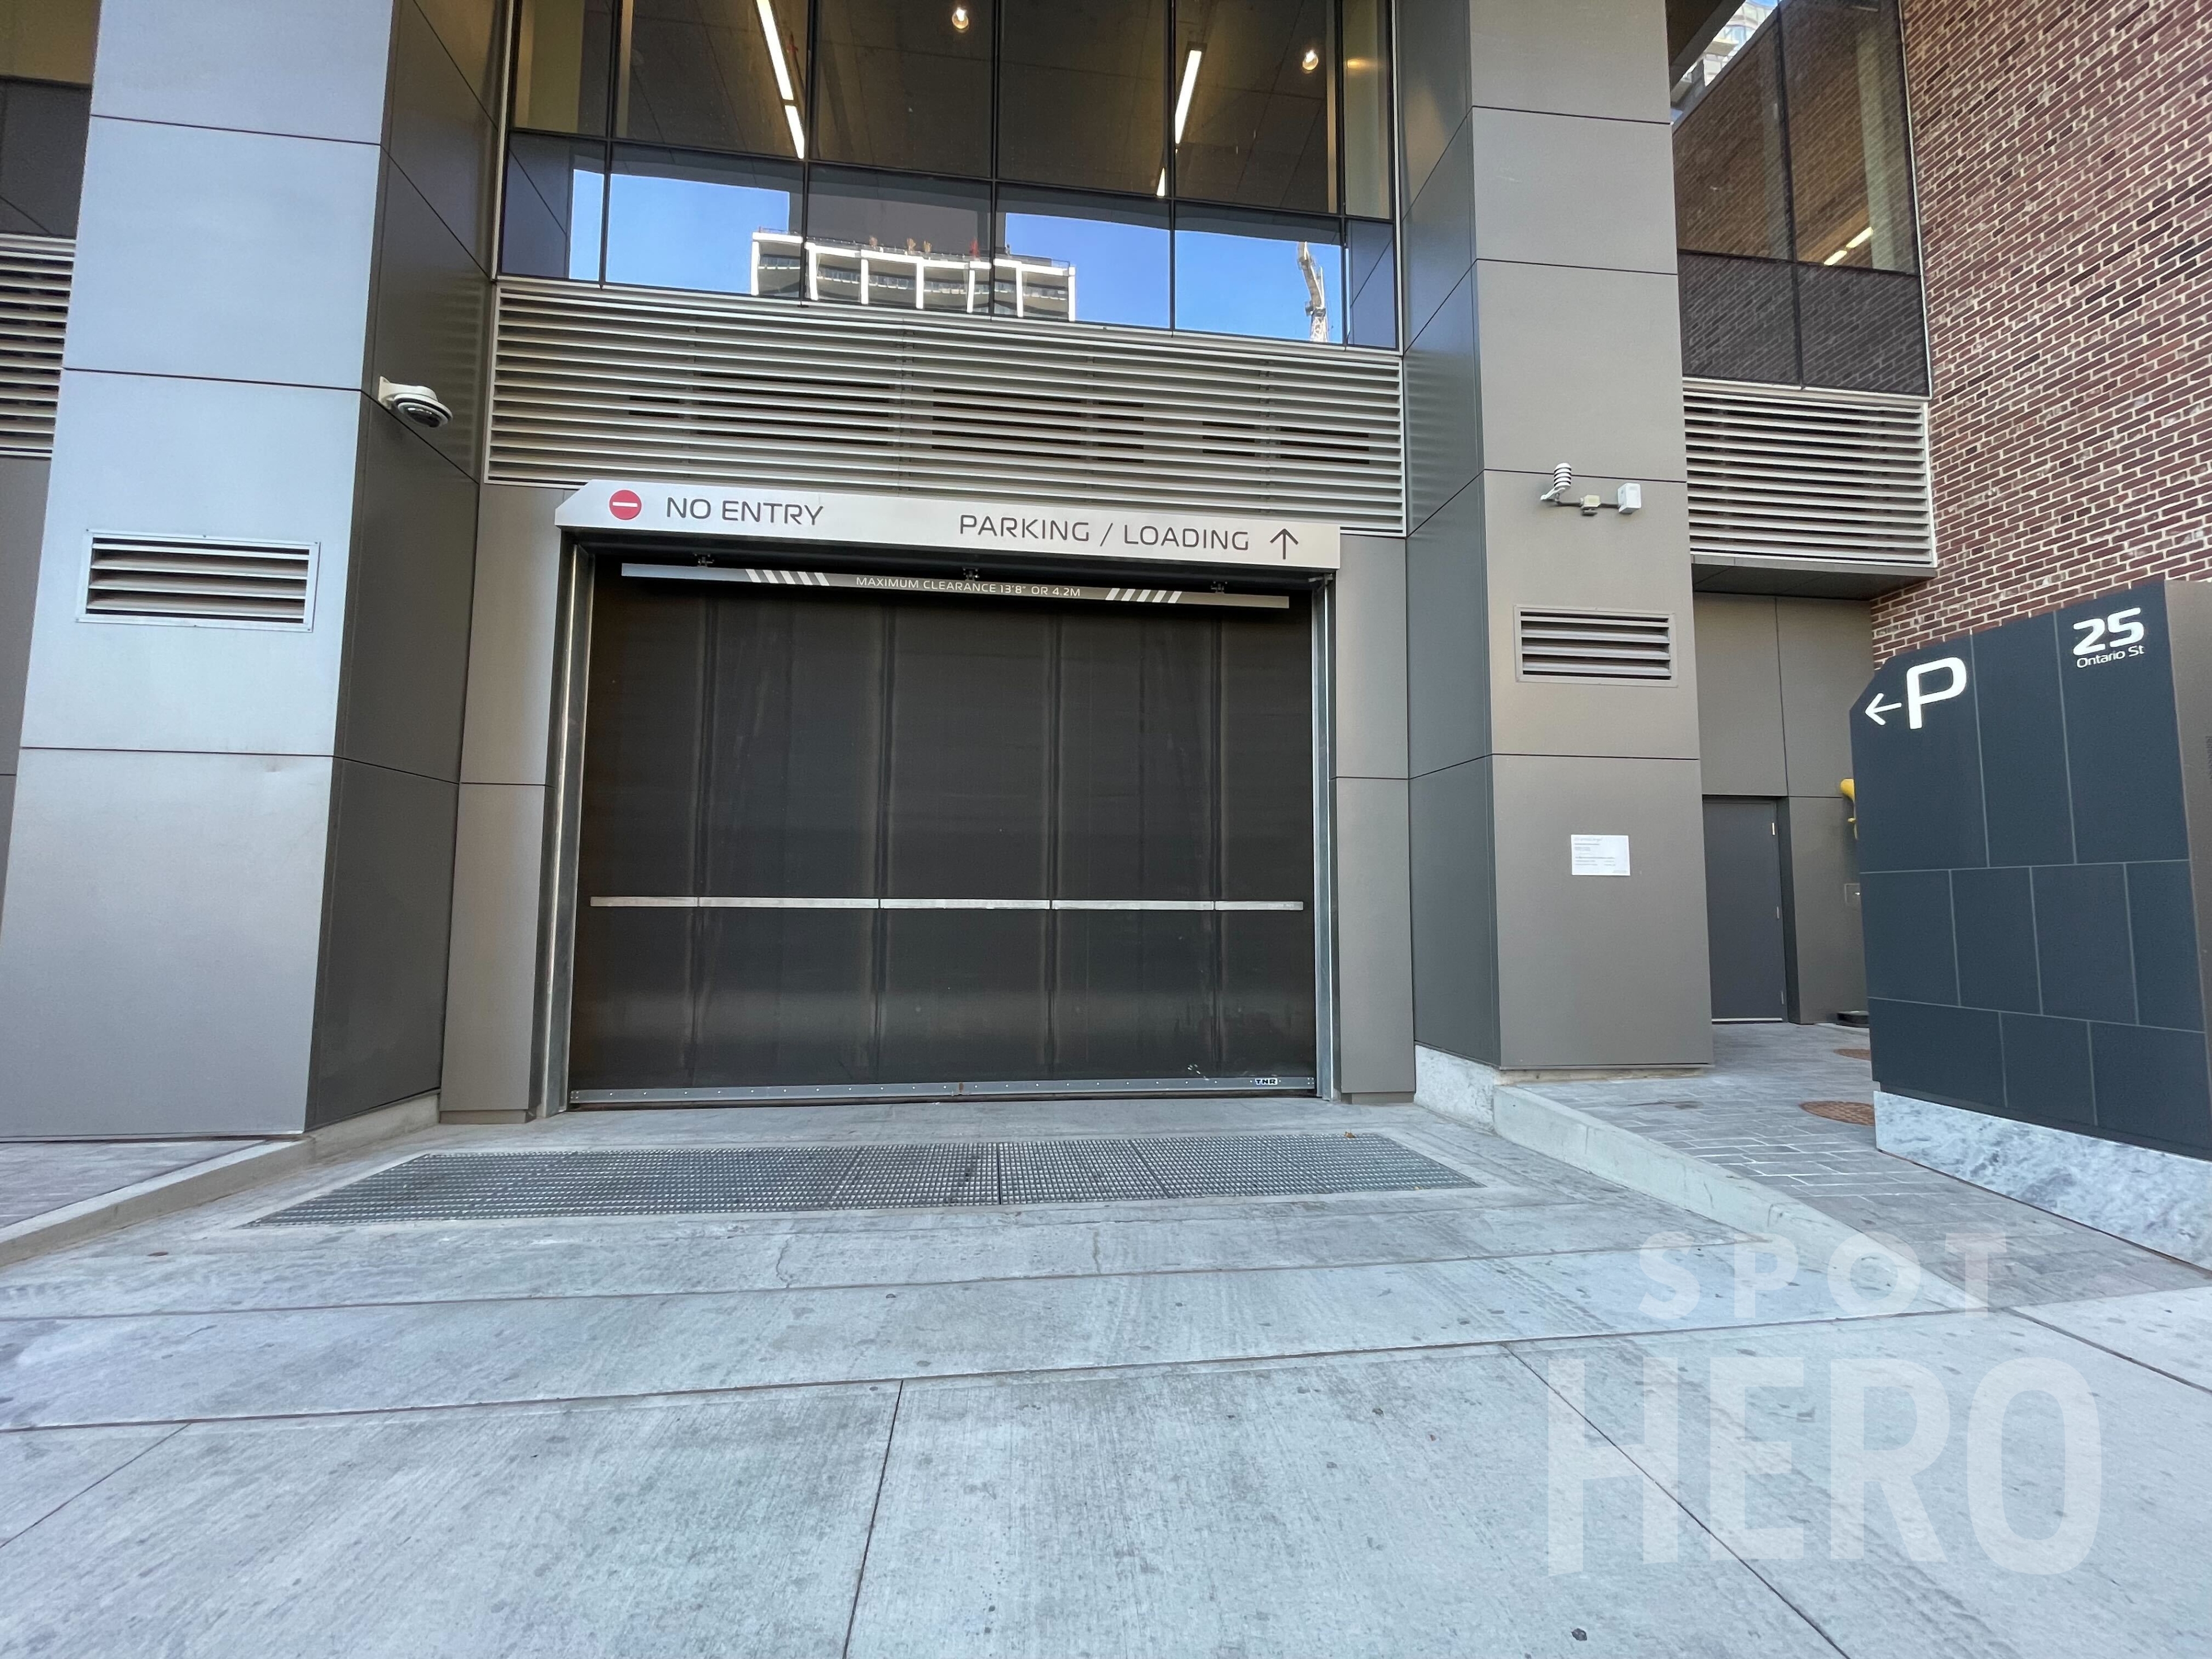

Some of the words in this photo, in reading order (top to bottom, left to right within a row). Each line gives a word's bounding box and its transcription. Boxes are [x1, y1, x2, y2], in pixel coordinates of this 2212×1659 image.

[666, 497, 711, 519] NO
[722, 500, 824, 525] ENTRY
[960, 514, 1089, 542] PARKING
[1100, 522, 1113, 547] /
[1124, 524, 1249, 551] LOADING
[856, 577, 919, 589] MAXIMUM
[923, 580, 996, 593] CLEARANCE
[1031, 585, 1048, 595] OR
[1052, 587, 1081, 597] 4.2M
[2073, 607, 2145, 656] 25
[2077, 650, 2126, 668] Ontario
[2128, 645, 2145, 657] St
[1906, 656, 1967, 730] P
